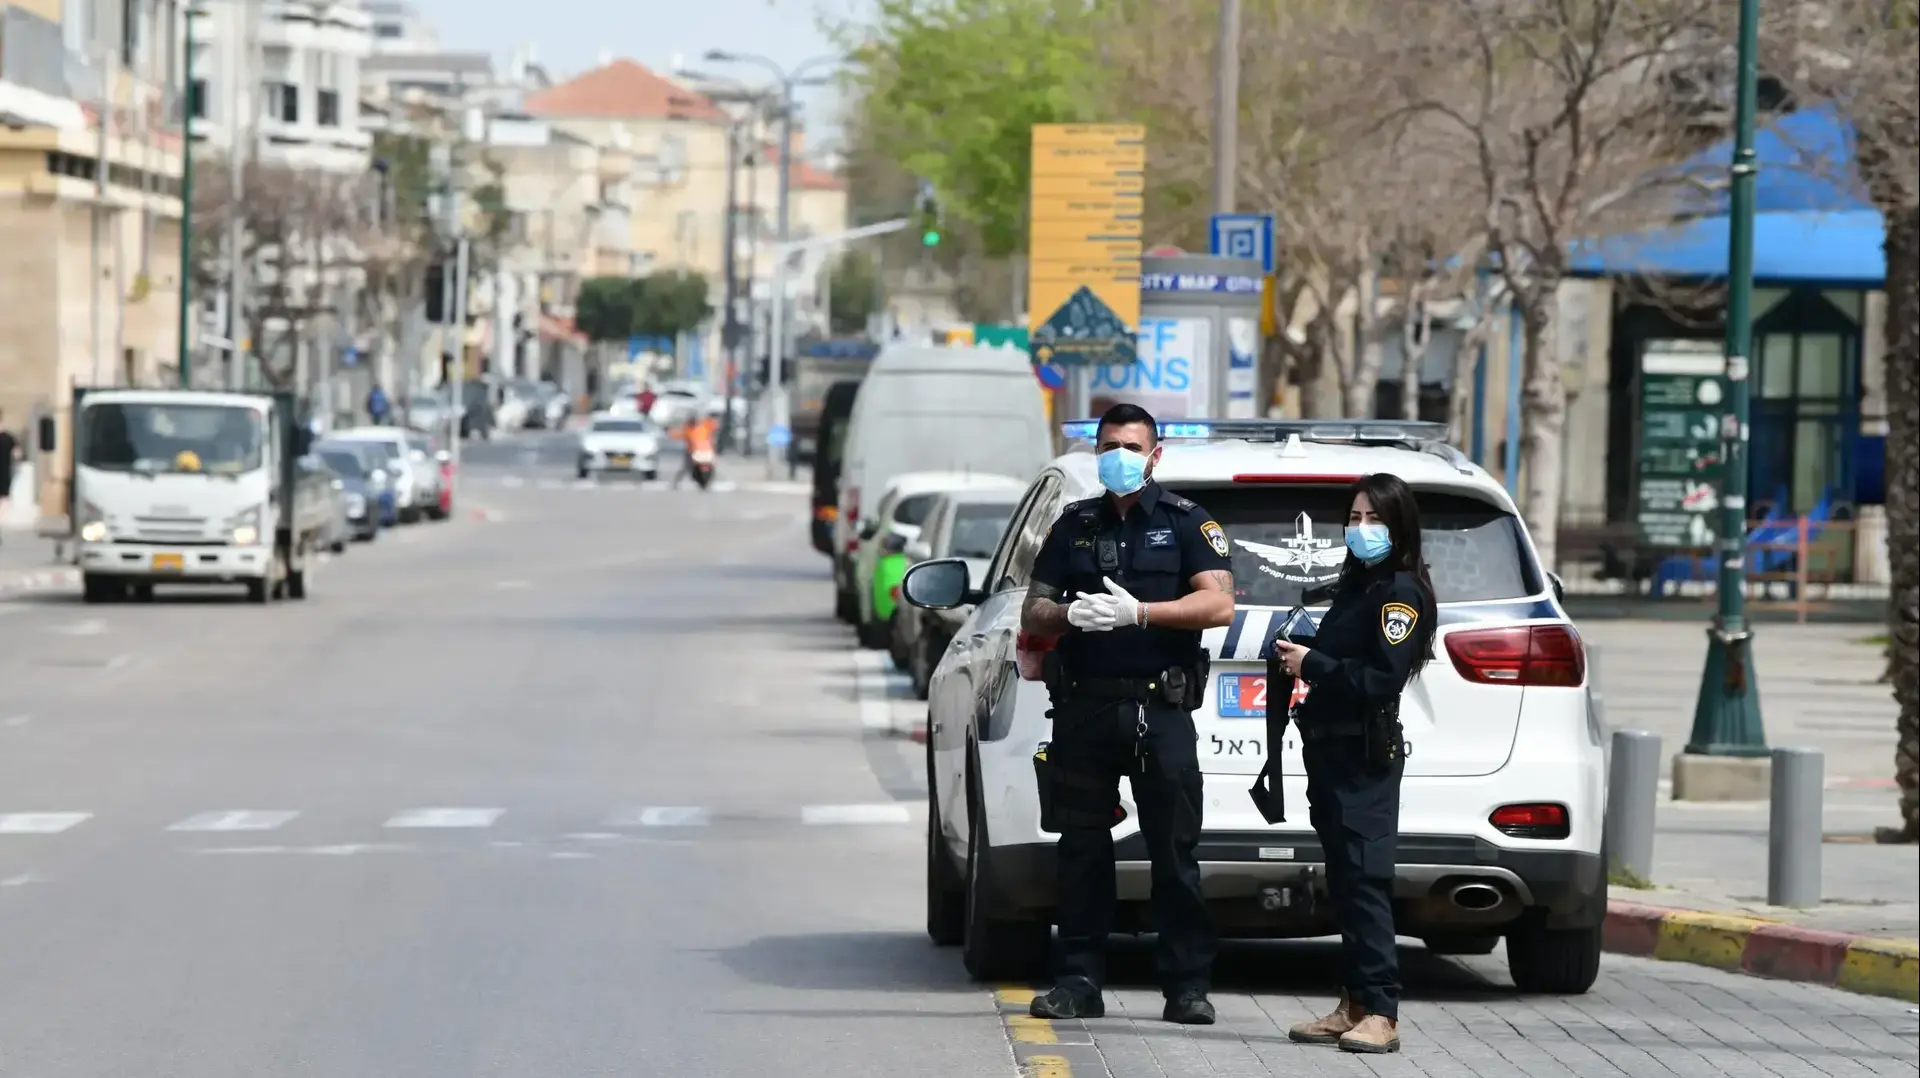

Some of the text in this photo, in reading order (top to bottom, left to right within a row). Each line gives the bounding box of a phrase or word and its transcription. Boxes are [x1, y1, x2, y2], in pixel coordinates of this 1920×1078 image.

[1179, 275, 1218, 290] MAP
[1225, 685, 1237, 699] IL
[1211, 734, 1294, 755] יראל
